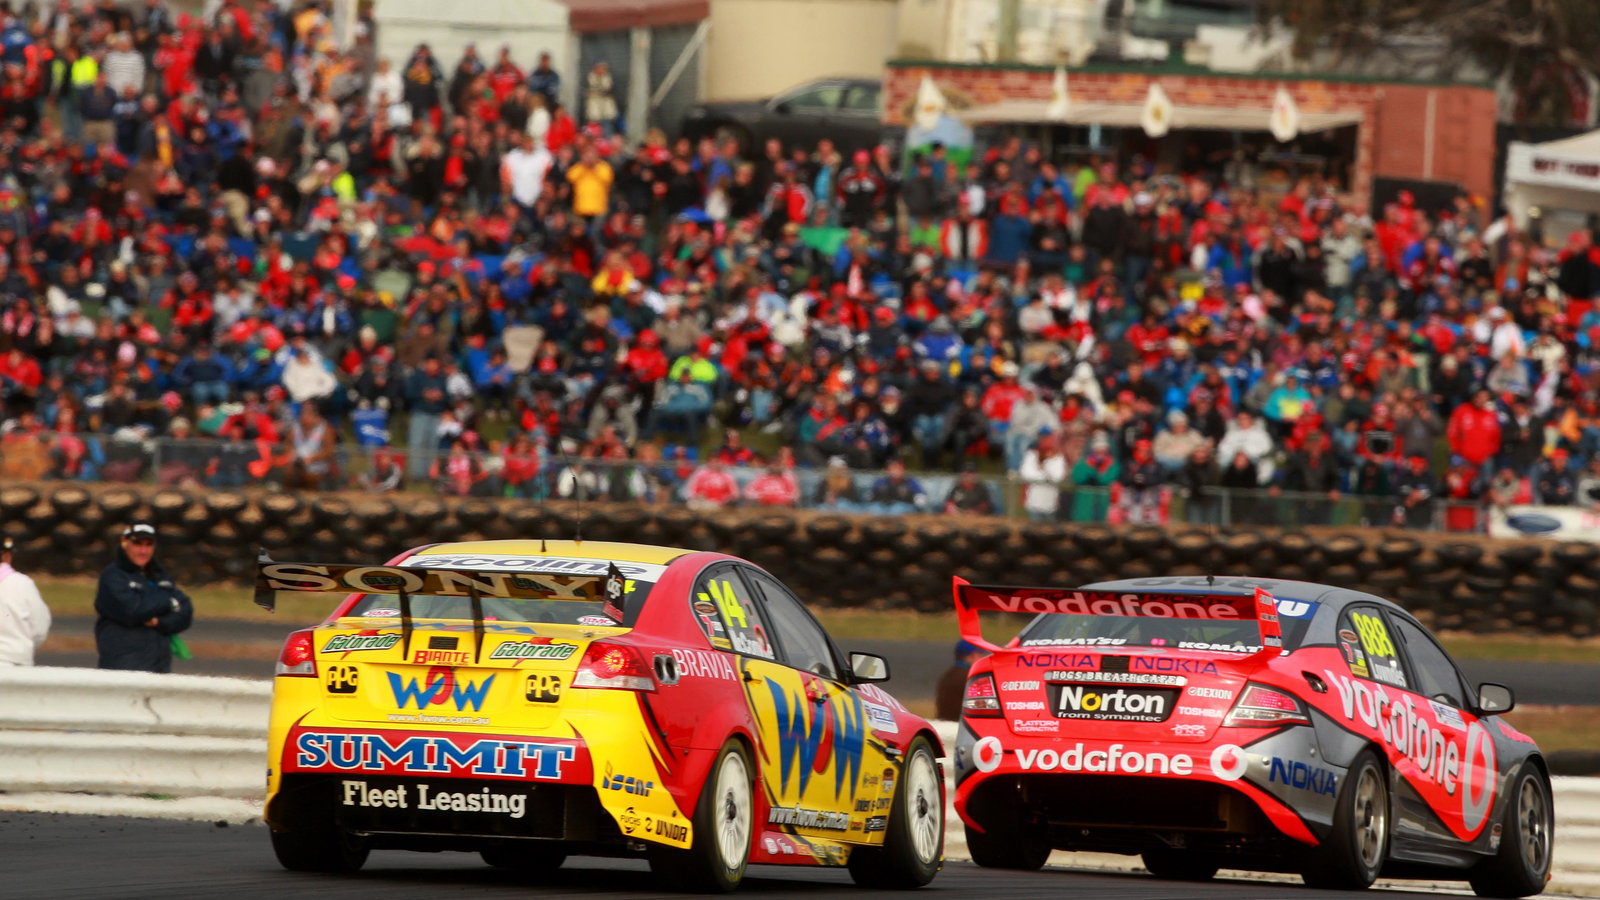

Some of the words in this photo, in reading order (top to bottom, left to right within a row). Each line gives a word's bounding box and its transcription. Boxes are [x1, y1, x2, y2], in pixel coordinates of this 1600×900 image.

[410, 557, 647, 575] ecoline
[262, 564, 601, 602] SONY
[709, 579, 748, 628] 14
[988, 592, 1240, 619] vodafone
[325, 634, 403, 652] Gatorade
[1023, 637, 1127, 647] KOMATSU
[1352, 612, 1394, 658] 888
[414, 650, 471, 664] BIANTE
[495, 642, 578, 658] Gatorade
[1016, 654, 1094, 668] NOKIA
[672, 649, 737, 682] BRAVIA
[1135, 656, 1219, 675] NOKIA
[327, 666, 358, 690] PPG
[386, 666, 497, 712] WOW
[526, 674, 560, 699] PPG
[1008, 681, 1040, 691] DEXION
[1052, 671, 1082, 681] HOGS
[1086, 671, 1138, 682] BREATH
[1142, 674, 1178, 685] CAFE
[1059, 686, 1165, 714] Norton
[1197, 687, 1232, 700] DEXION
[1005, 701, 1045, 710] TOSHIBA
[1058, 711, 1091, 720] from
[1094, 713, 1162, 723] symantec
[1178, 706, 1223, 719] TOSHIBA
[1014, 719, 1060, 727] PLATFORM
[763, 675, 865, 804] WOW
[296, 732, 576, 781] SUMMIT
[1015, 743, 1193, 775] vodafone
[1269, 756, 1336, 799] NOKIA
[342, 780, 408, 809] Fleet
[416, 784, 527, 819] Leasing
[656, 820, 688, 843] UNIOR
